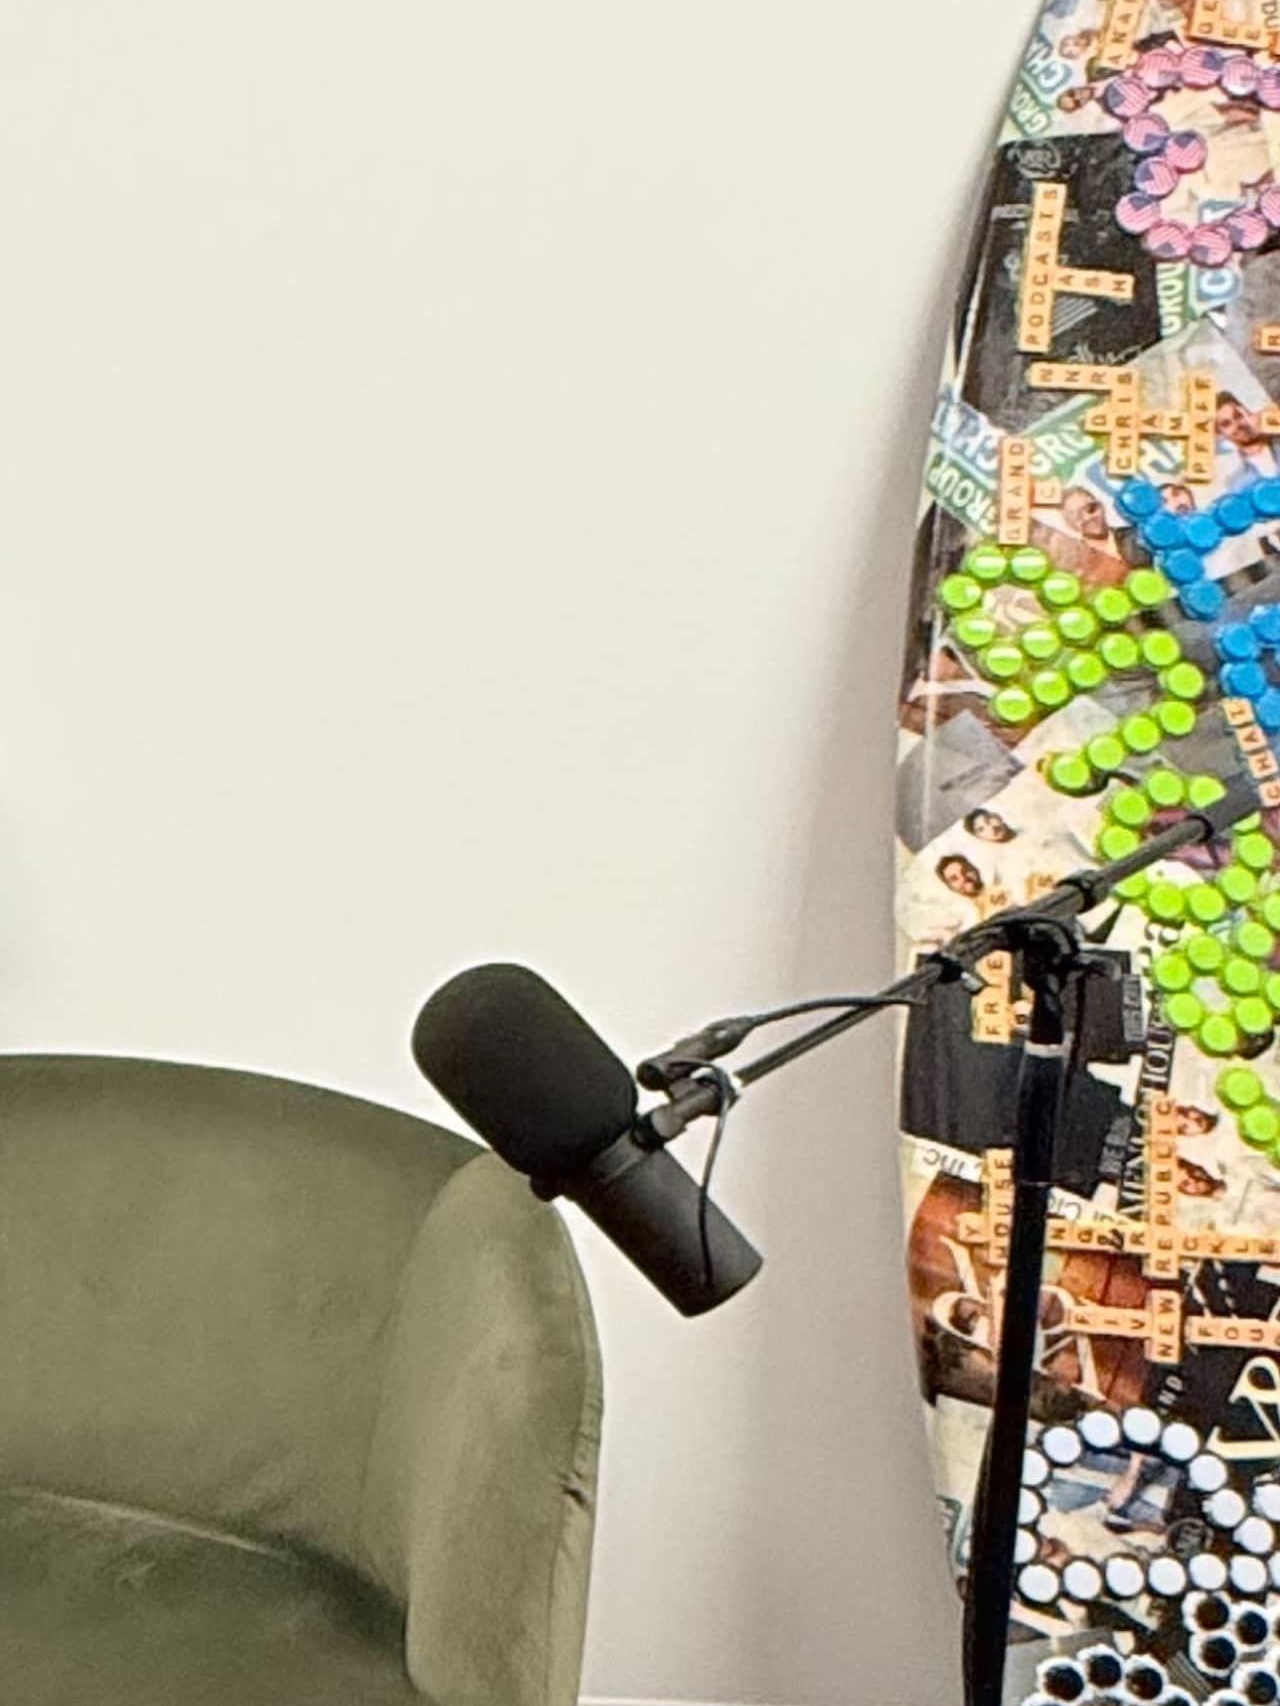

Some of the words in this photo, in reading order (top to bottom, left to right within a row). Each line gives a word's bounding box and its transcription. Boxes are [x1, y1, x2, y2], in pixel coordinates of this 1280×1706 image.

[1027, 189, 1058, 345] PODCASTS
[1115, 372, 1133, 471] CHRIS
[1006, 442, 1025, 541] GRAND
[1157, 1099, 1175, 1272] REPUBLIC
[1157, 1297, 1175, 1357] NEW
